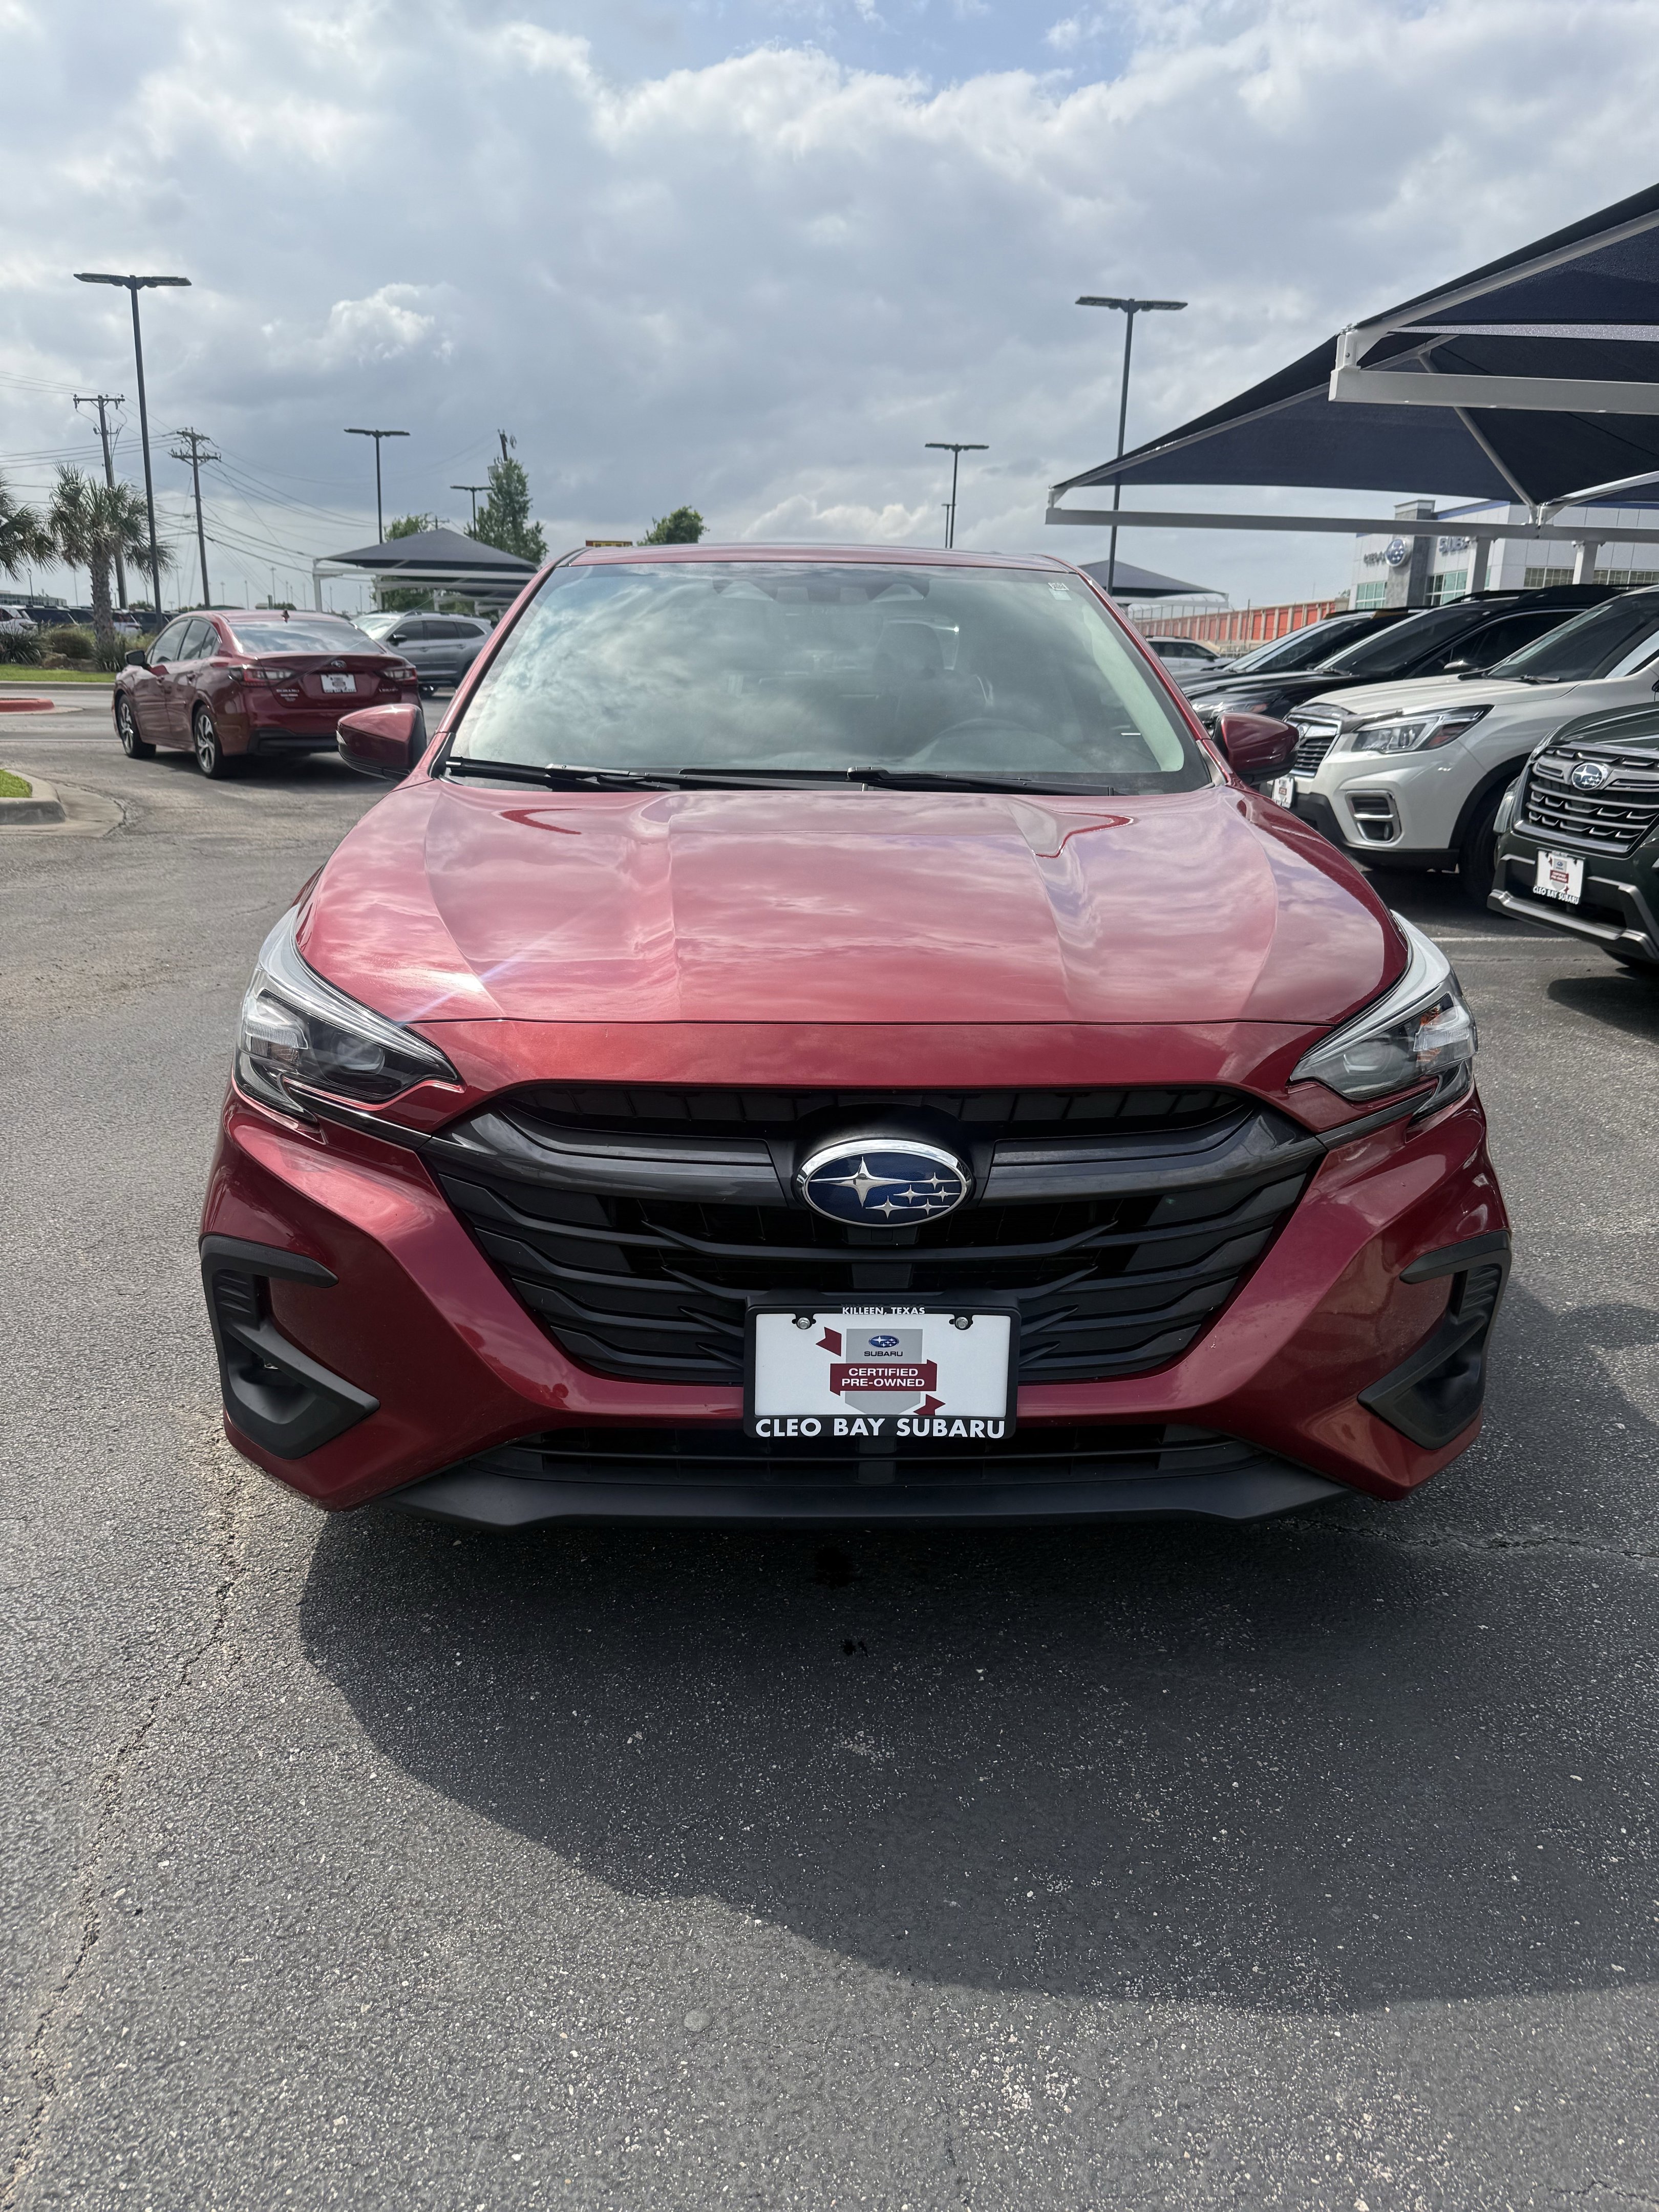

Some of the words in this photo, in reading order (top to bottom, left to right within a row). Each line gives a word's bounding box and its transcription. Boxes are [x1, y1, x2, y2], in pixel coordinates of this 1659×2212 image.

[1533, 886, 1546, 896] CLEO
[1547, 890, 1558, 899] BAY
[1558, 892, 1579, 905] SUBARU
[842, 1307, 887, 1315] KILLEEN,
[848, 1368, 919, 1376] CERTIFIED
[841, 1378, 925, 1387] PRE-OWNED
[755, 1417, 822, 1437] CLEO
[834, 1418, 885, 1436] BAY
[896, 1418, 1005, 1439] SUBARU
